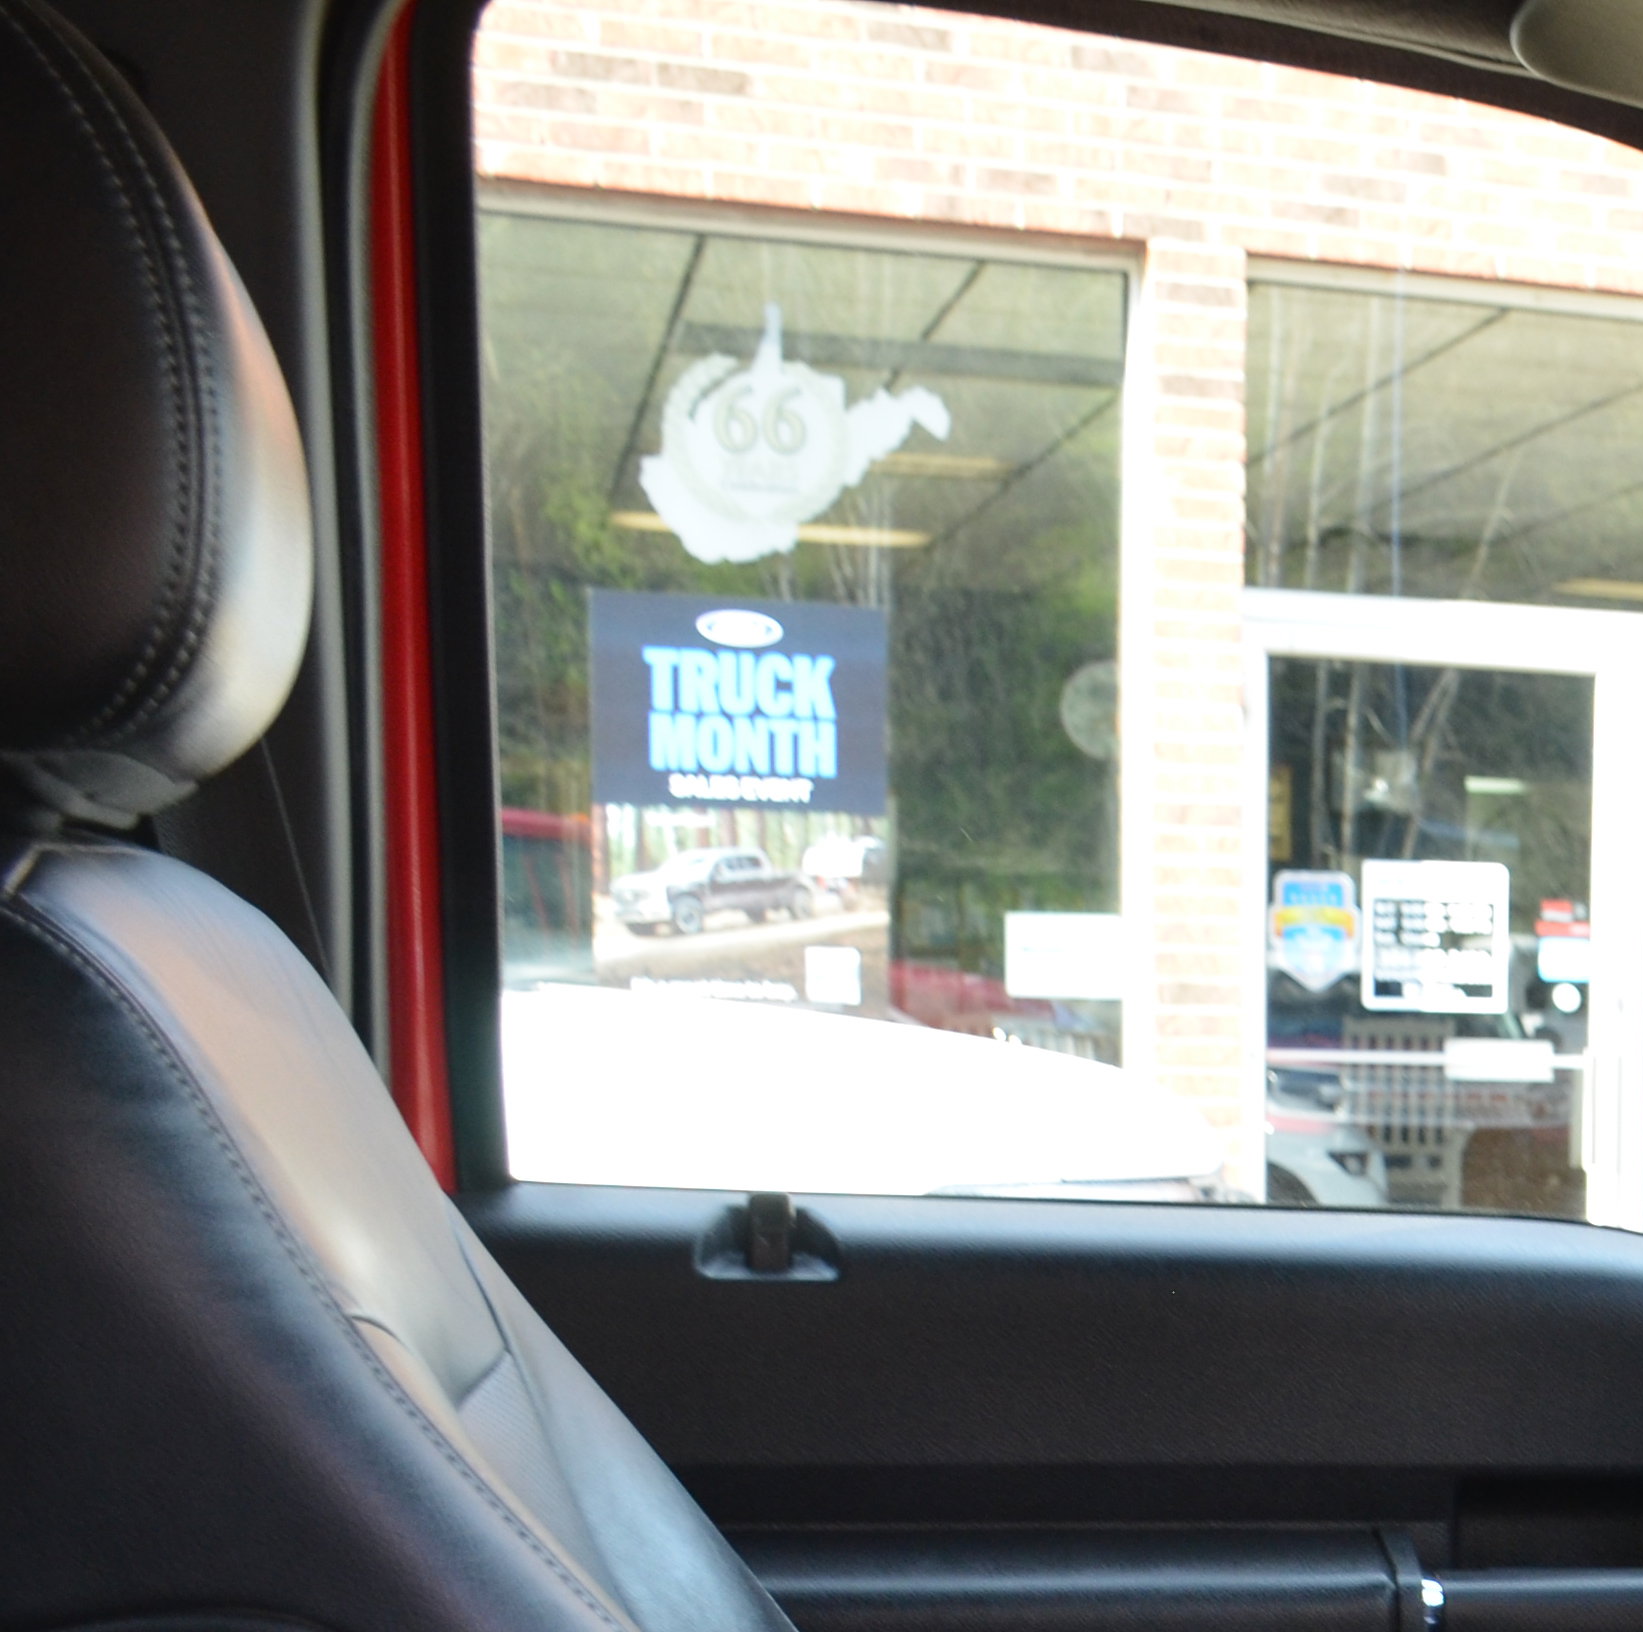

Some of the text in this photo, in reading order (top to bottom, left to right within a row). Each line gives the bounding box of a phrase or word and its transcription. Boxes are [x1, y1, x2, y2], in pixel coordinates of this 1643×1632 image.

[714, 384, 808, 456] 66
[641, 645, 836, 721] TRUCK
[648, 711, 838, 780] MONTH
